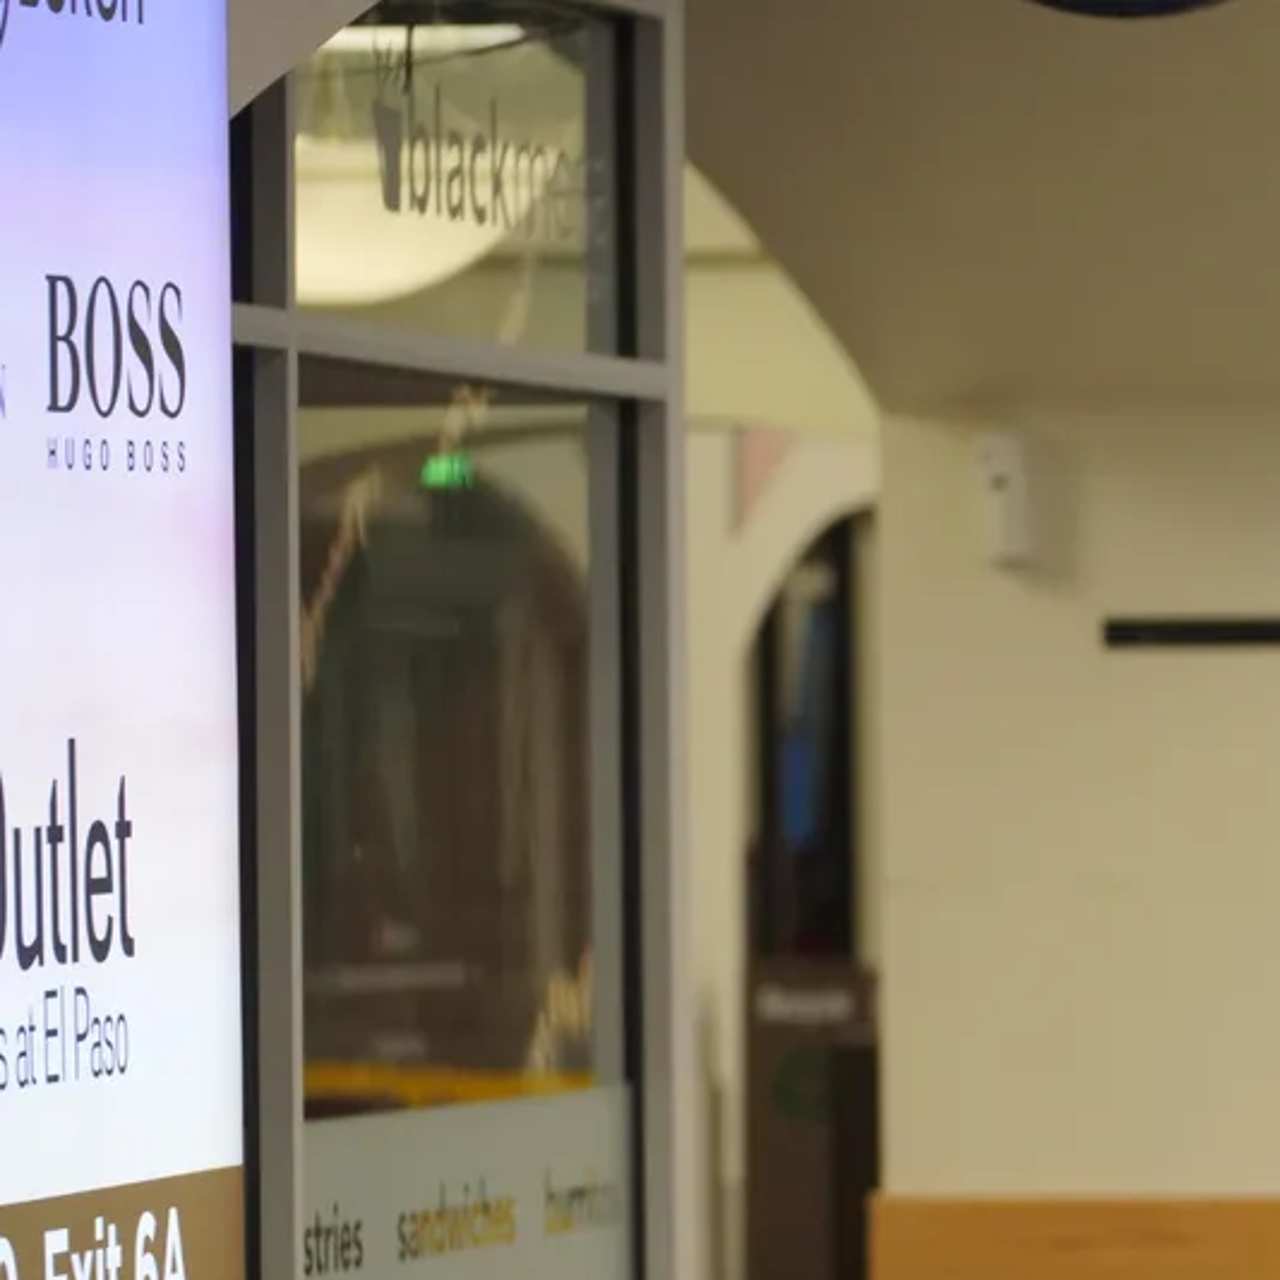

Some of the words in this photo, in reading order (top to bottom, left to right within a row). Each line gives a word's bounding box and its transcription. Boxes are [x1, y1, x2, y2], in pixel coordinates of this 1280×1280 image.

[45, 273, 186, 418] BOSS
[47, 436, 109, 472] HUGO
[126, 437, 187, 473] BOSS
[0, 737, 136, 971] utlet
[15, 1006, 37, 1089] at
[74, 985, 129, 1081] Paso
[303, 1202, 364, 1277] stries
[397, 1176, 519, 1262] sandwiches
